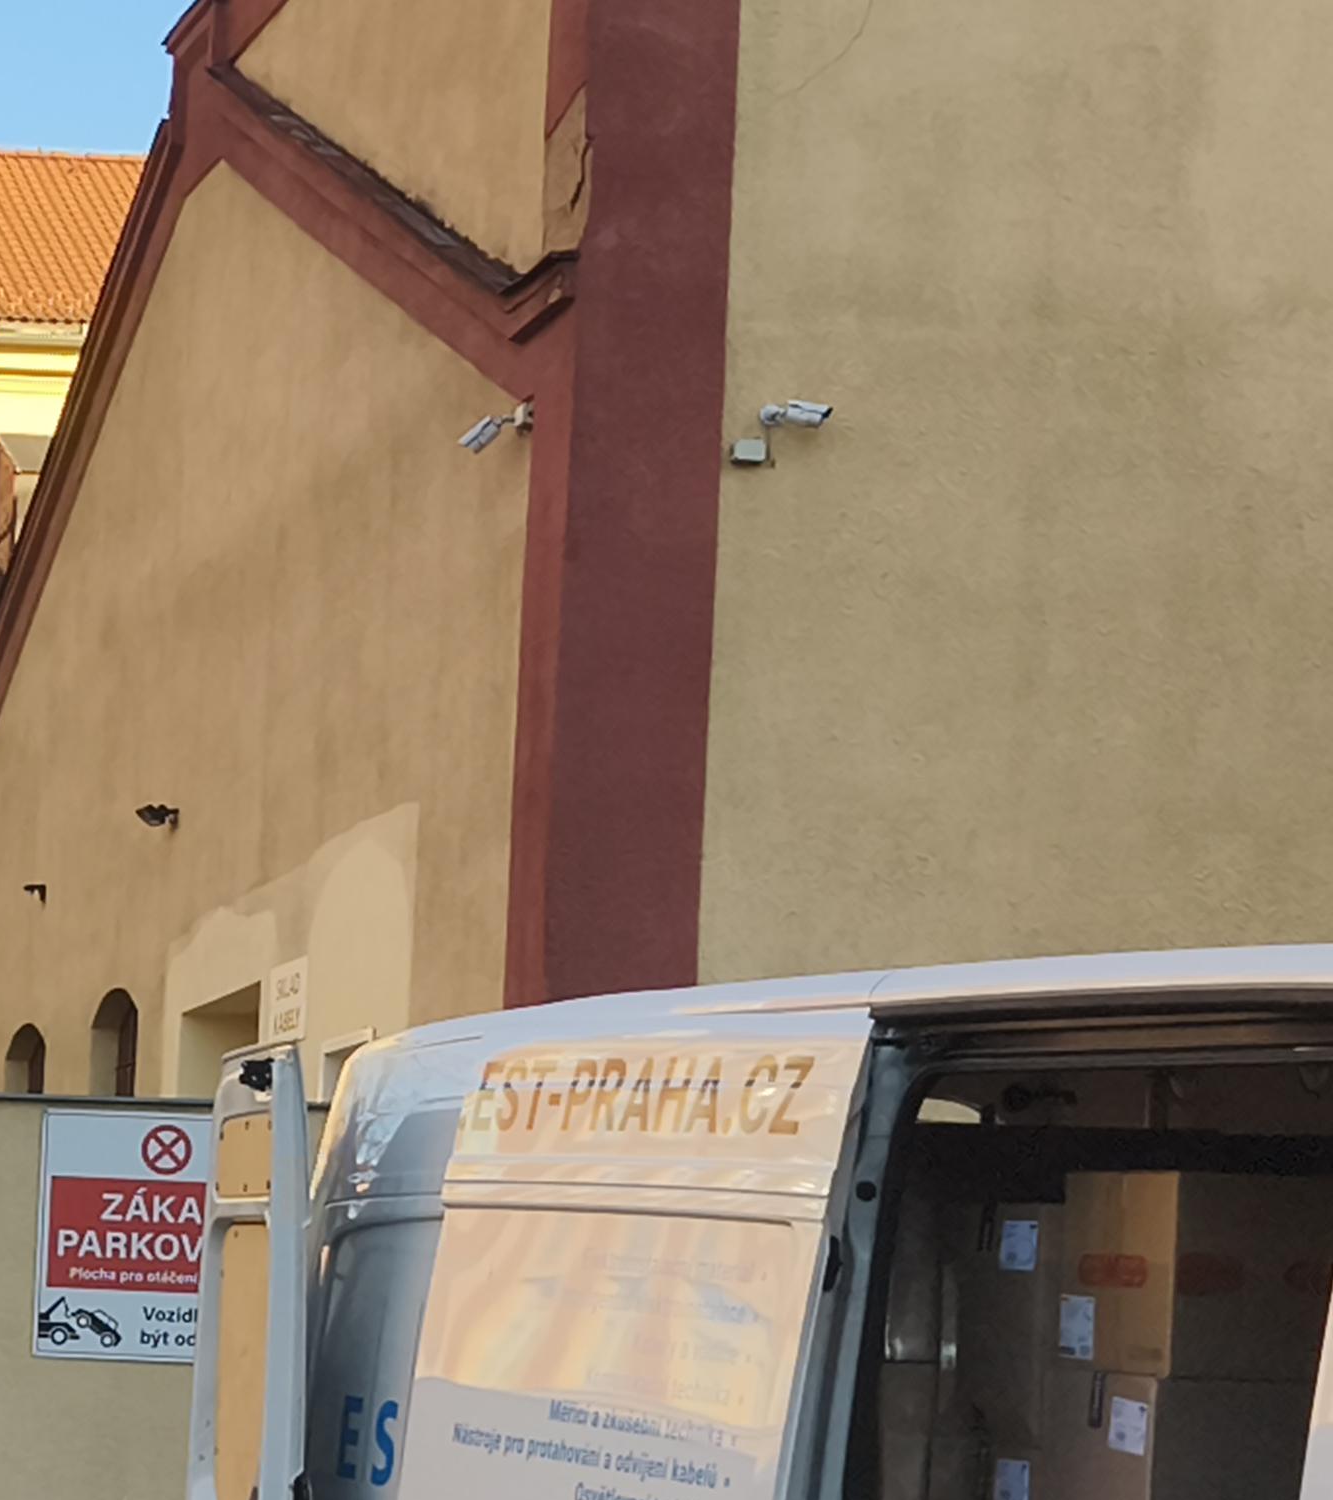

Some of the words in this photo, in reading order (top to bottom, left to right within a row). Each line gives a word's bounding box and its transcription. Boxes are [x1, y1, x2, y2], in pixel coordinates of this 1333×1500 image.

[100, 1187, 202, 1224] ZÁKA
[56, 1229, 204, 1262] PARKOV
[69, 1266, 117, 1281] Plocha
[120, 1270, 143, 1285] pro
[142, 1306, 198, 1323] Vozidl
[140, 1328, 169, 1349] být
[590, 1409, 599, 1428] a
[337, 1395, 399, 1486] ES
[452, 1422, 502, 1455] Nástroje
[504, 1435, 523, 1456] pro
[603, 1452, 611, 1470] a
